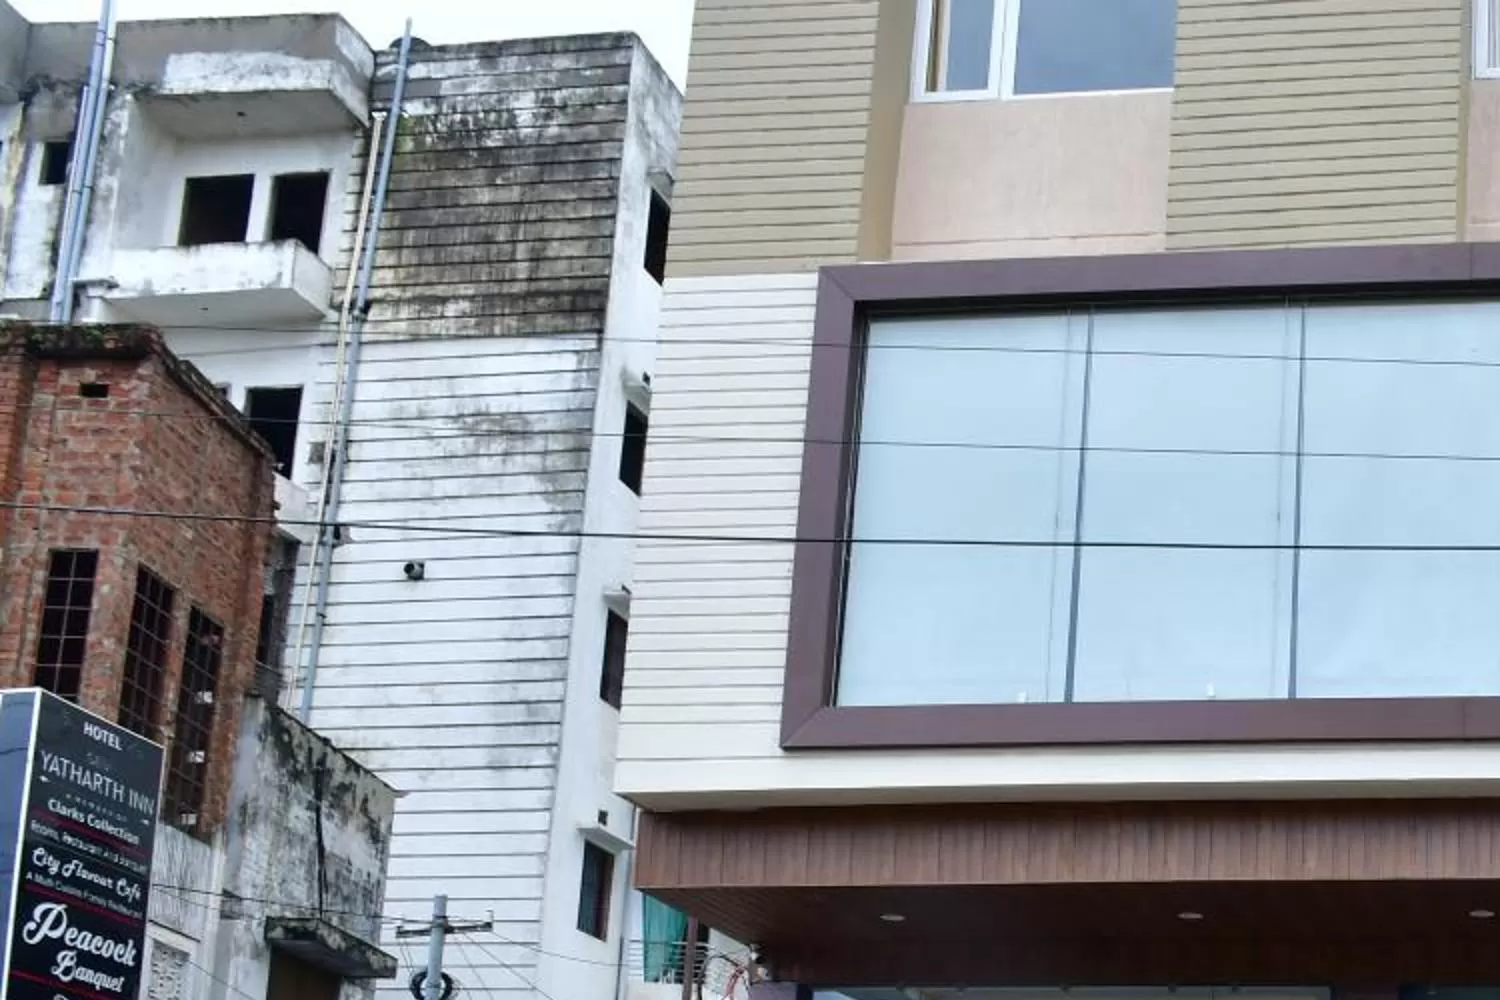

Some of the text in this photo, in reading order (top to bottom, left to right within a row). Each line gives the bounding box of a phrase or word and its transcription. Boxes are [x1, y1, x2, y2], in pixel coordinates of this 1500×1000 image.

[83, 721, 122, 751] HOTEL
[41, 748, 125, 803] YATHARTH
[128, 788, 155, 816] INN
[47, 798, 85, 823] Clarks
[87, 813, 140, 845] Collection
[32, 847, 60, 875] City
[22, 901, 137, 967] Peacock
[50, 949, 125, 993] Banquet
